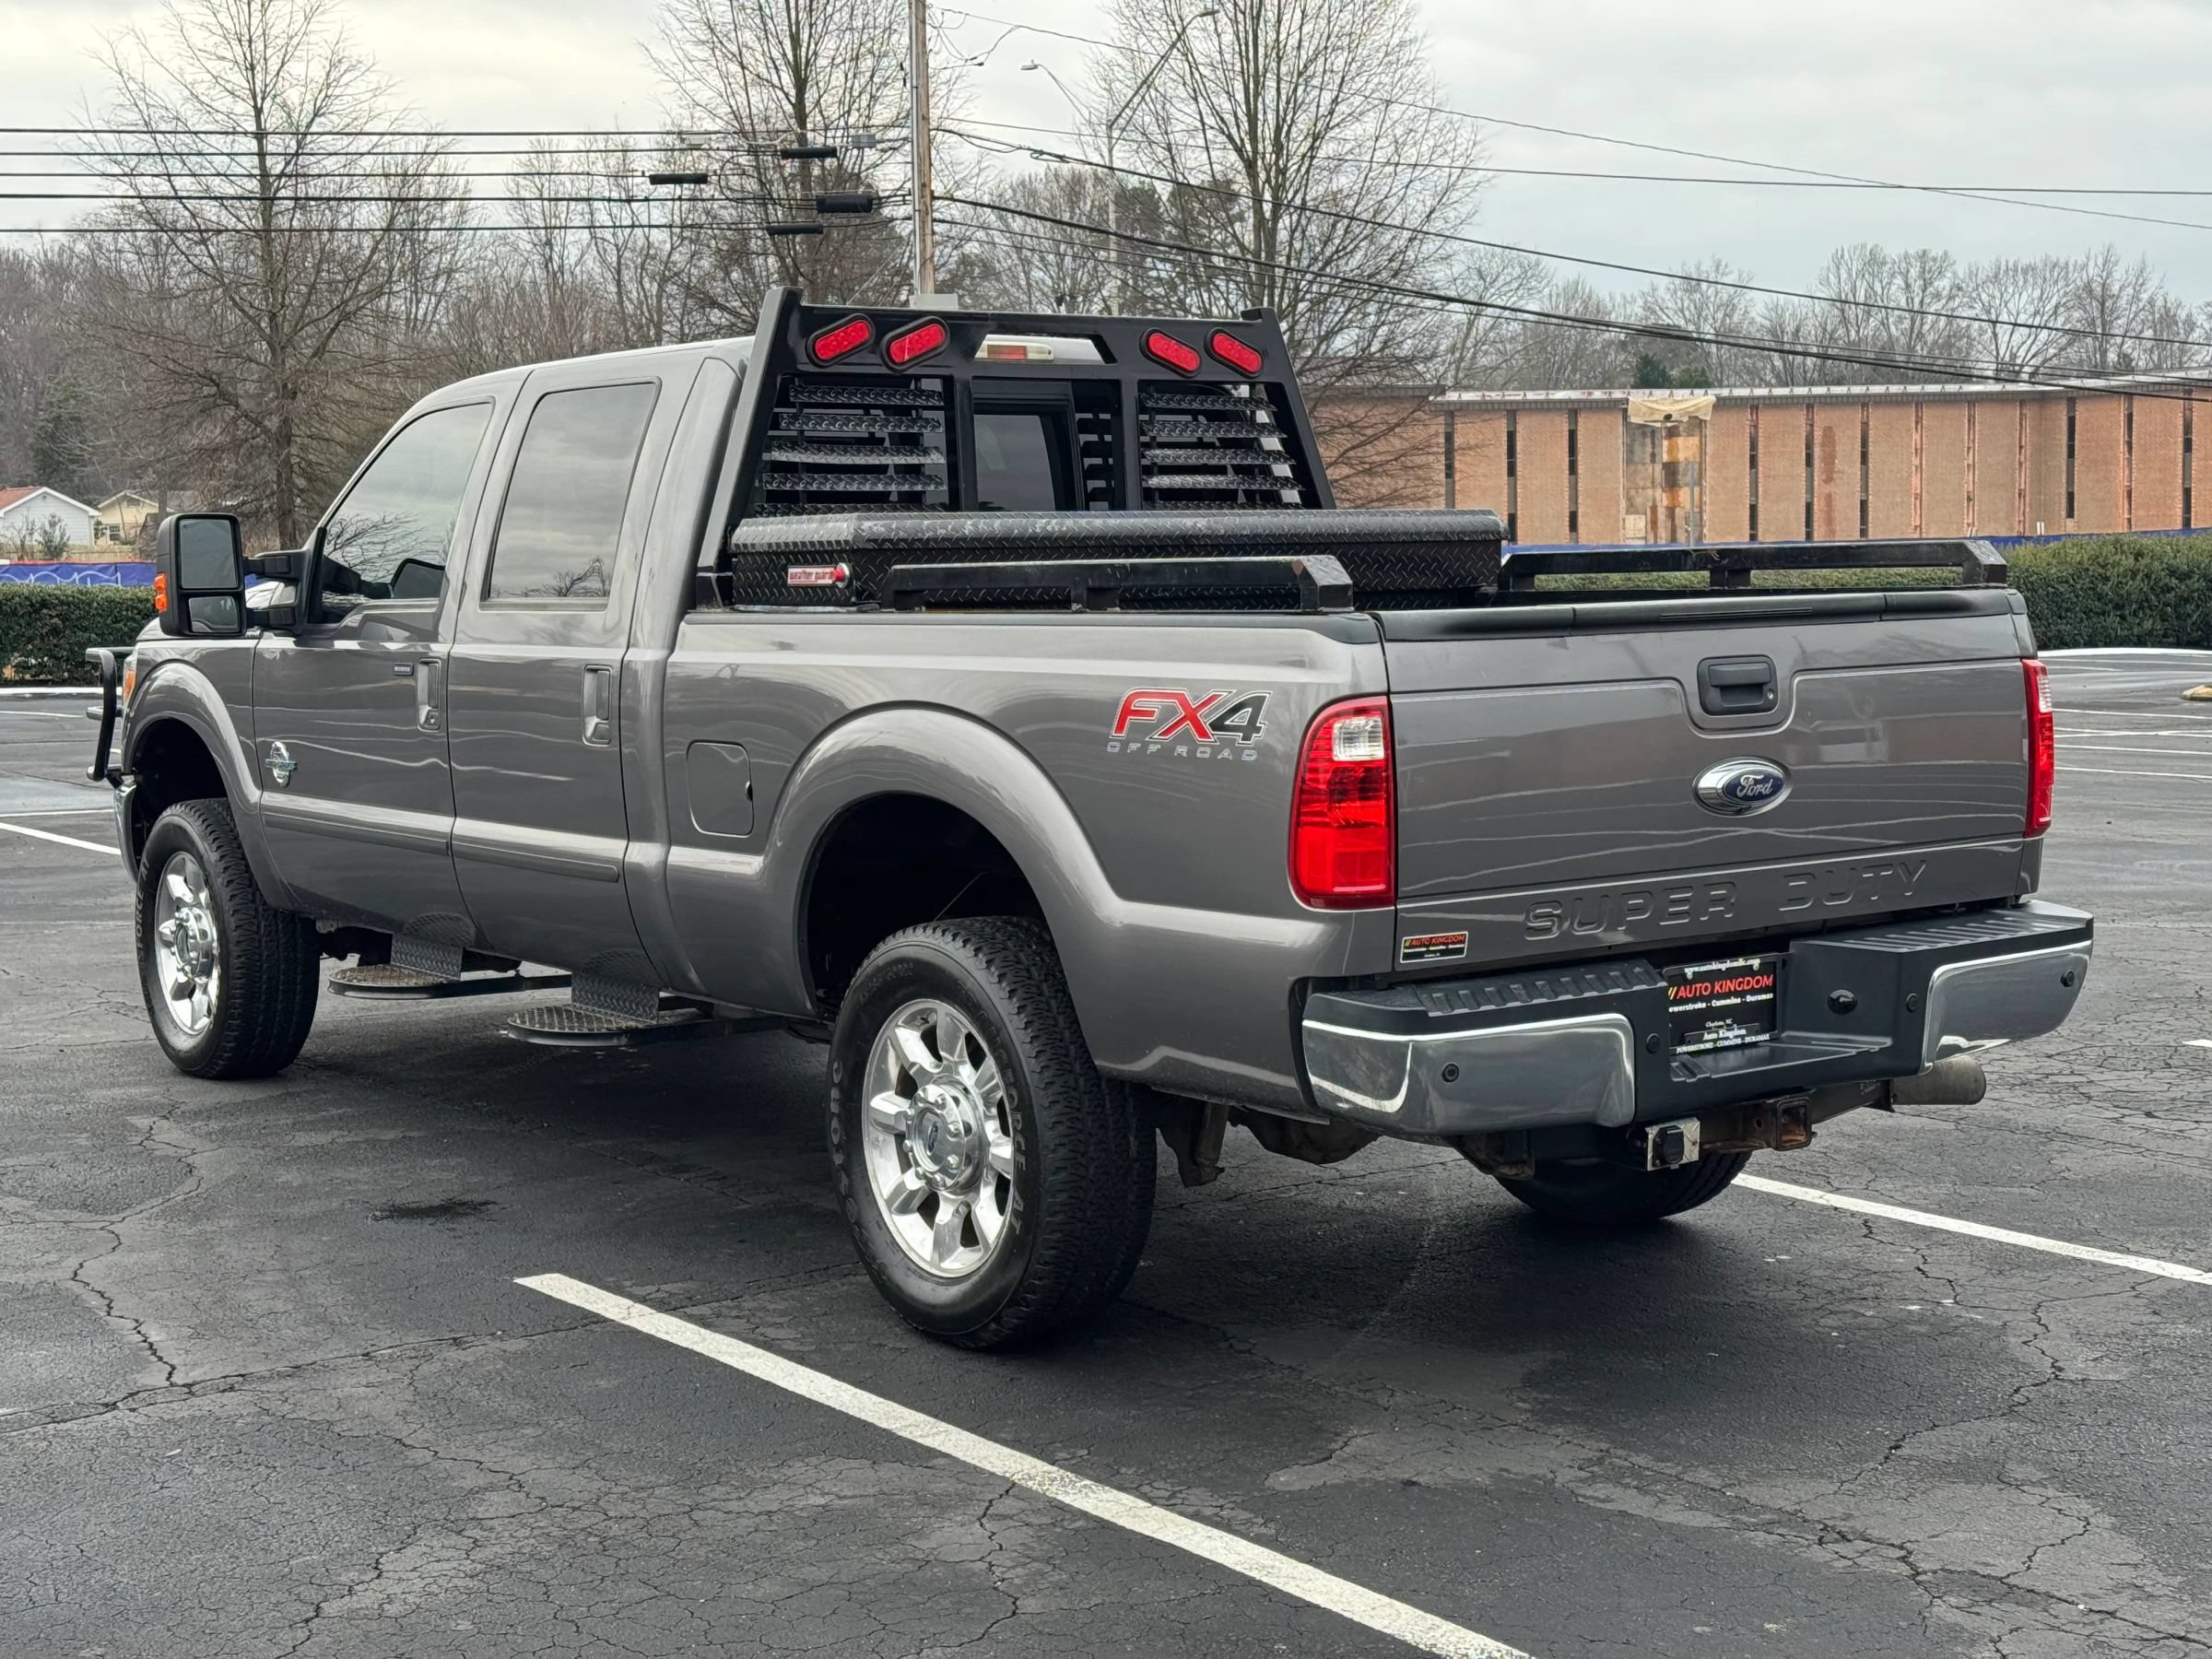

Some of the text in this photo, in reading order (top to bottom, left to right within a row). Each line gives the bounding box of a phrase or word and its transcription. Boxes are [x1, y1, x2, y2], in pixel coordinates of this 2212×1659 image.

[1109, 687, 1273, 746] FX4
[1106, 741, 1258, 761] OFF ROAD
[1736, 774, 1773, 798] Ford
[1524, 859, 1927, 941] SUPER DUTY
[1411, 935, 1465, 947] AUTO KINGDOM
[1677, 975, 1773, 999] AUTO KINGDOM
[1668, 994, 1773, 1013] owerstroke Cummins Duramax
